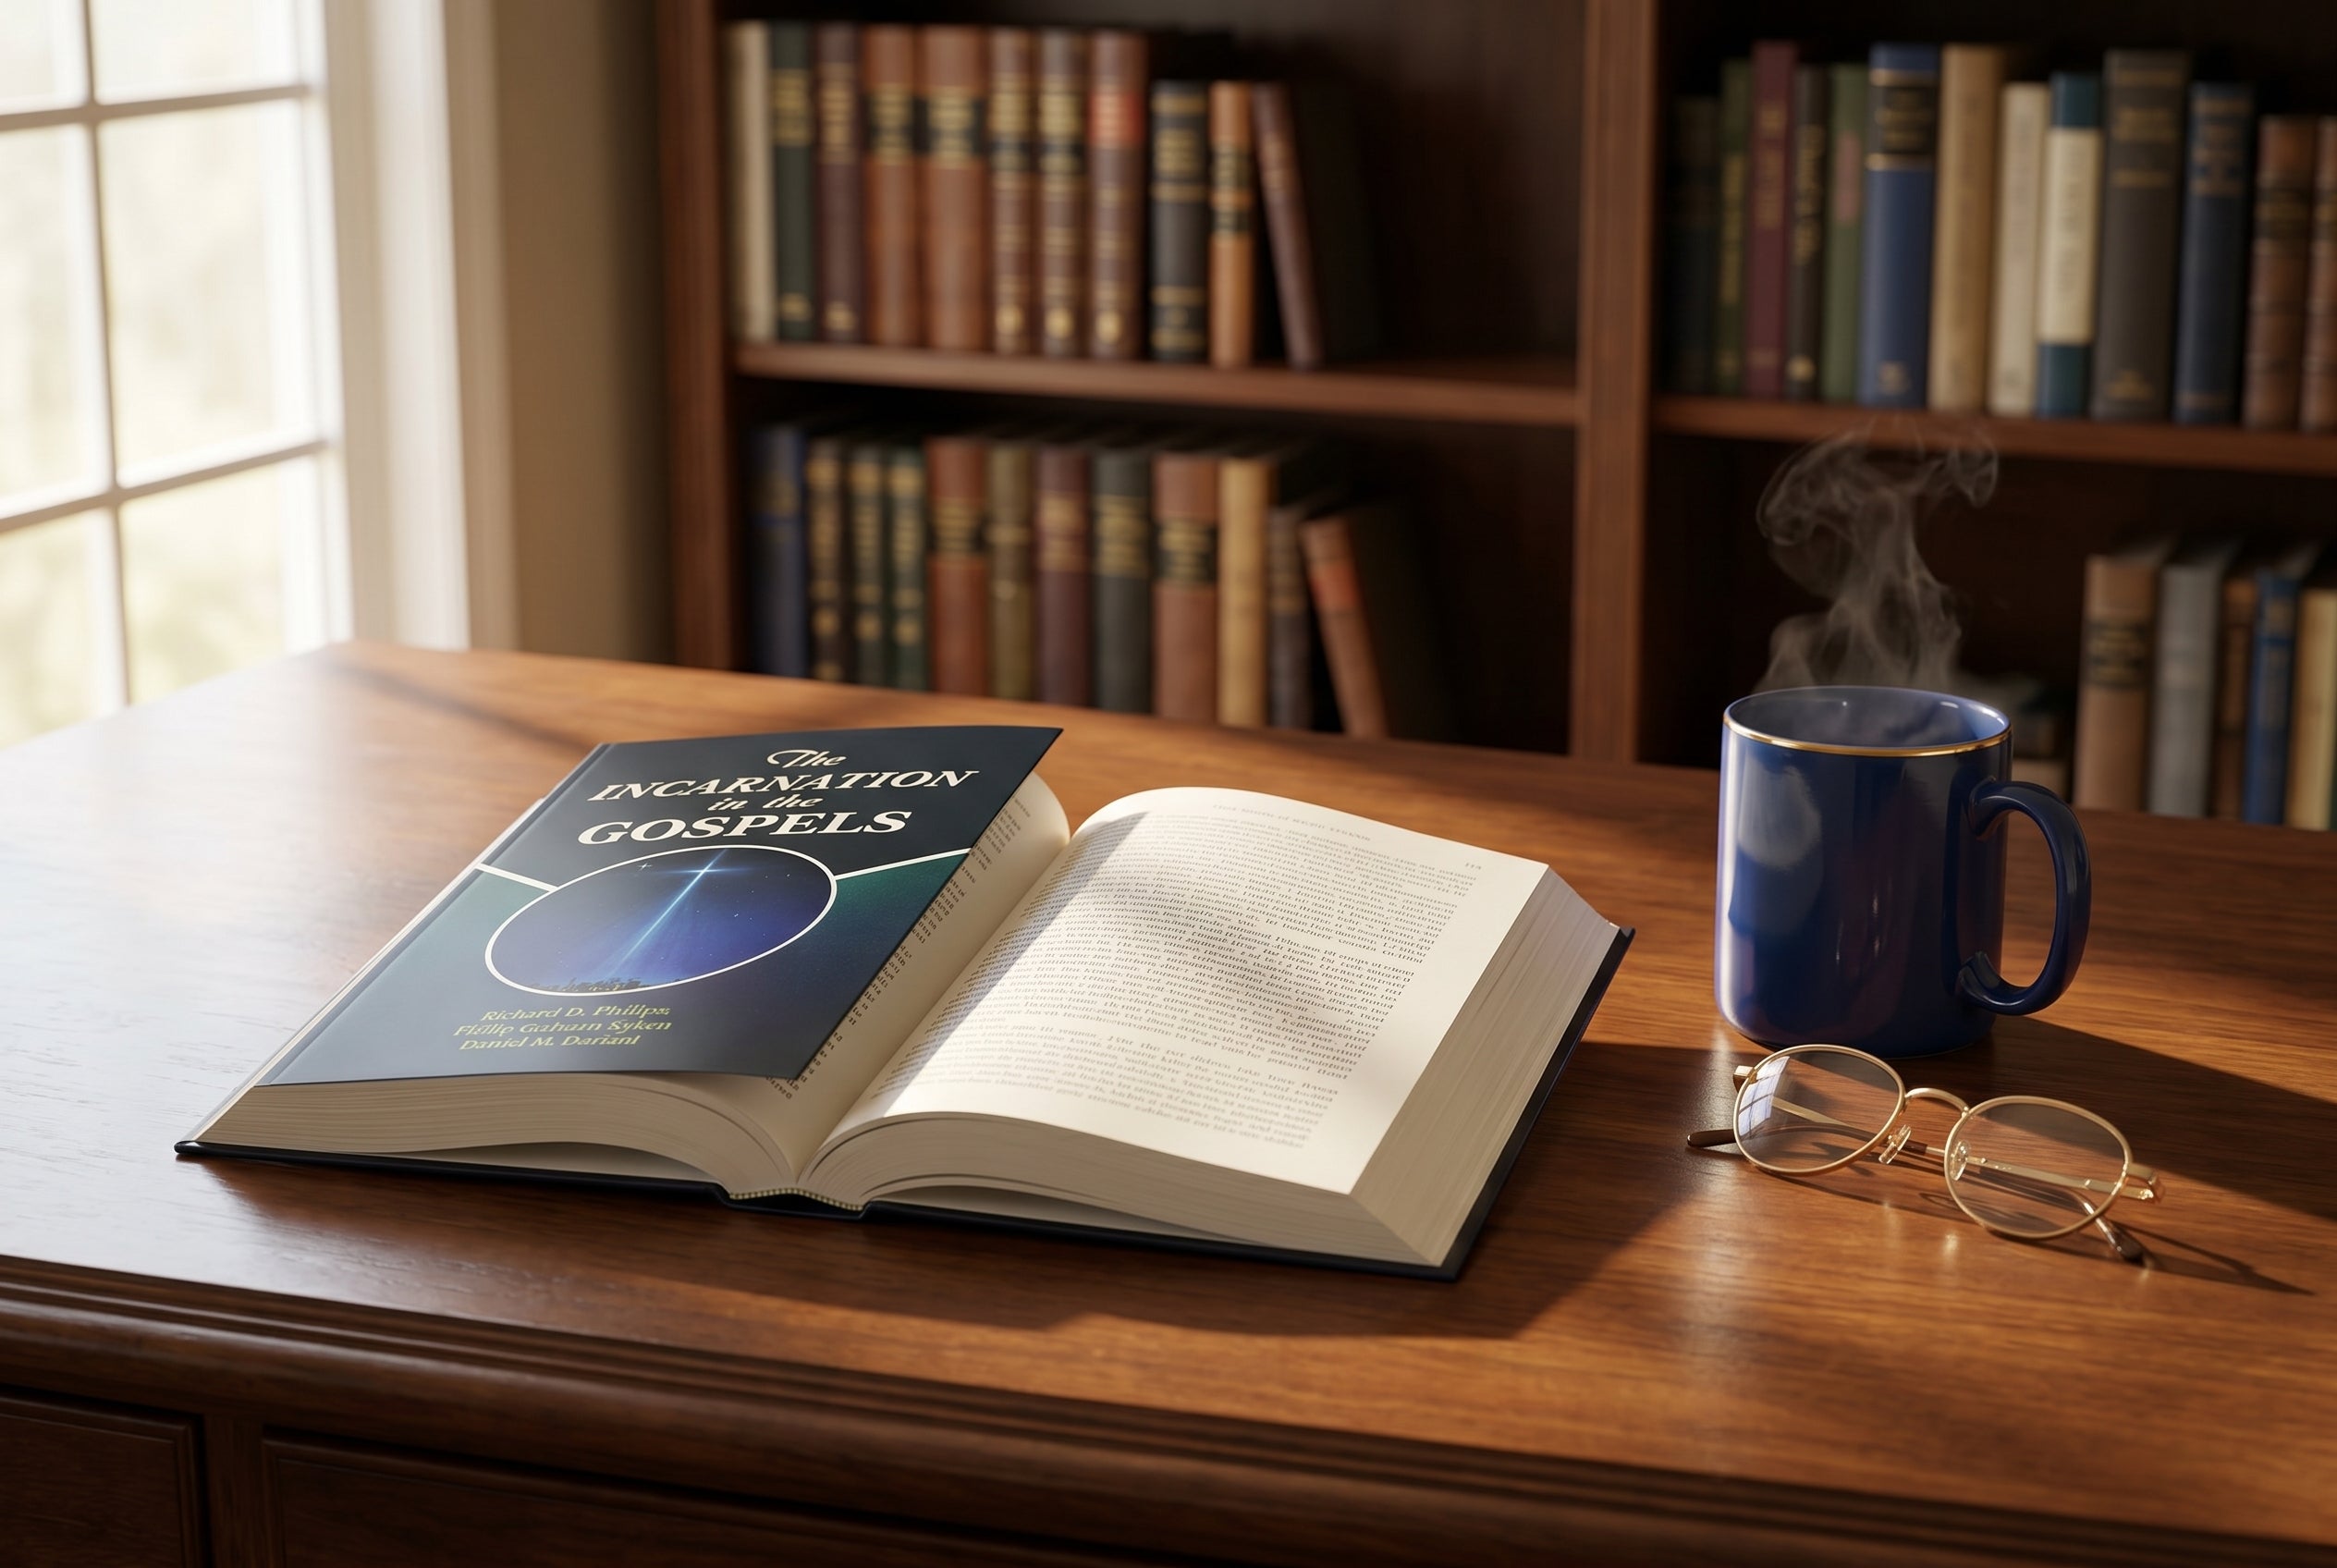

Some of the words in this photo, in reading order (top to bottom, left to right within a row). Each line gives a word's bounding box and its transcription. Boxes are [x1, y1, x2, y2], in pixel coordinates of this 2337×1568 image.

[766, 748, 847, 769] The
[587, 770, 980, 802] INCARNATION
[707, 796, 749, 813] in
[762, 793, 823, 810] the
[578, 810, 912, 845] GOSPELS
[481, 1006, 563, 1021] Richard
[564, 1006, 585, 1017] D.
